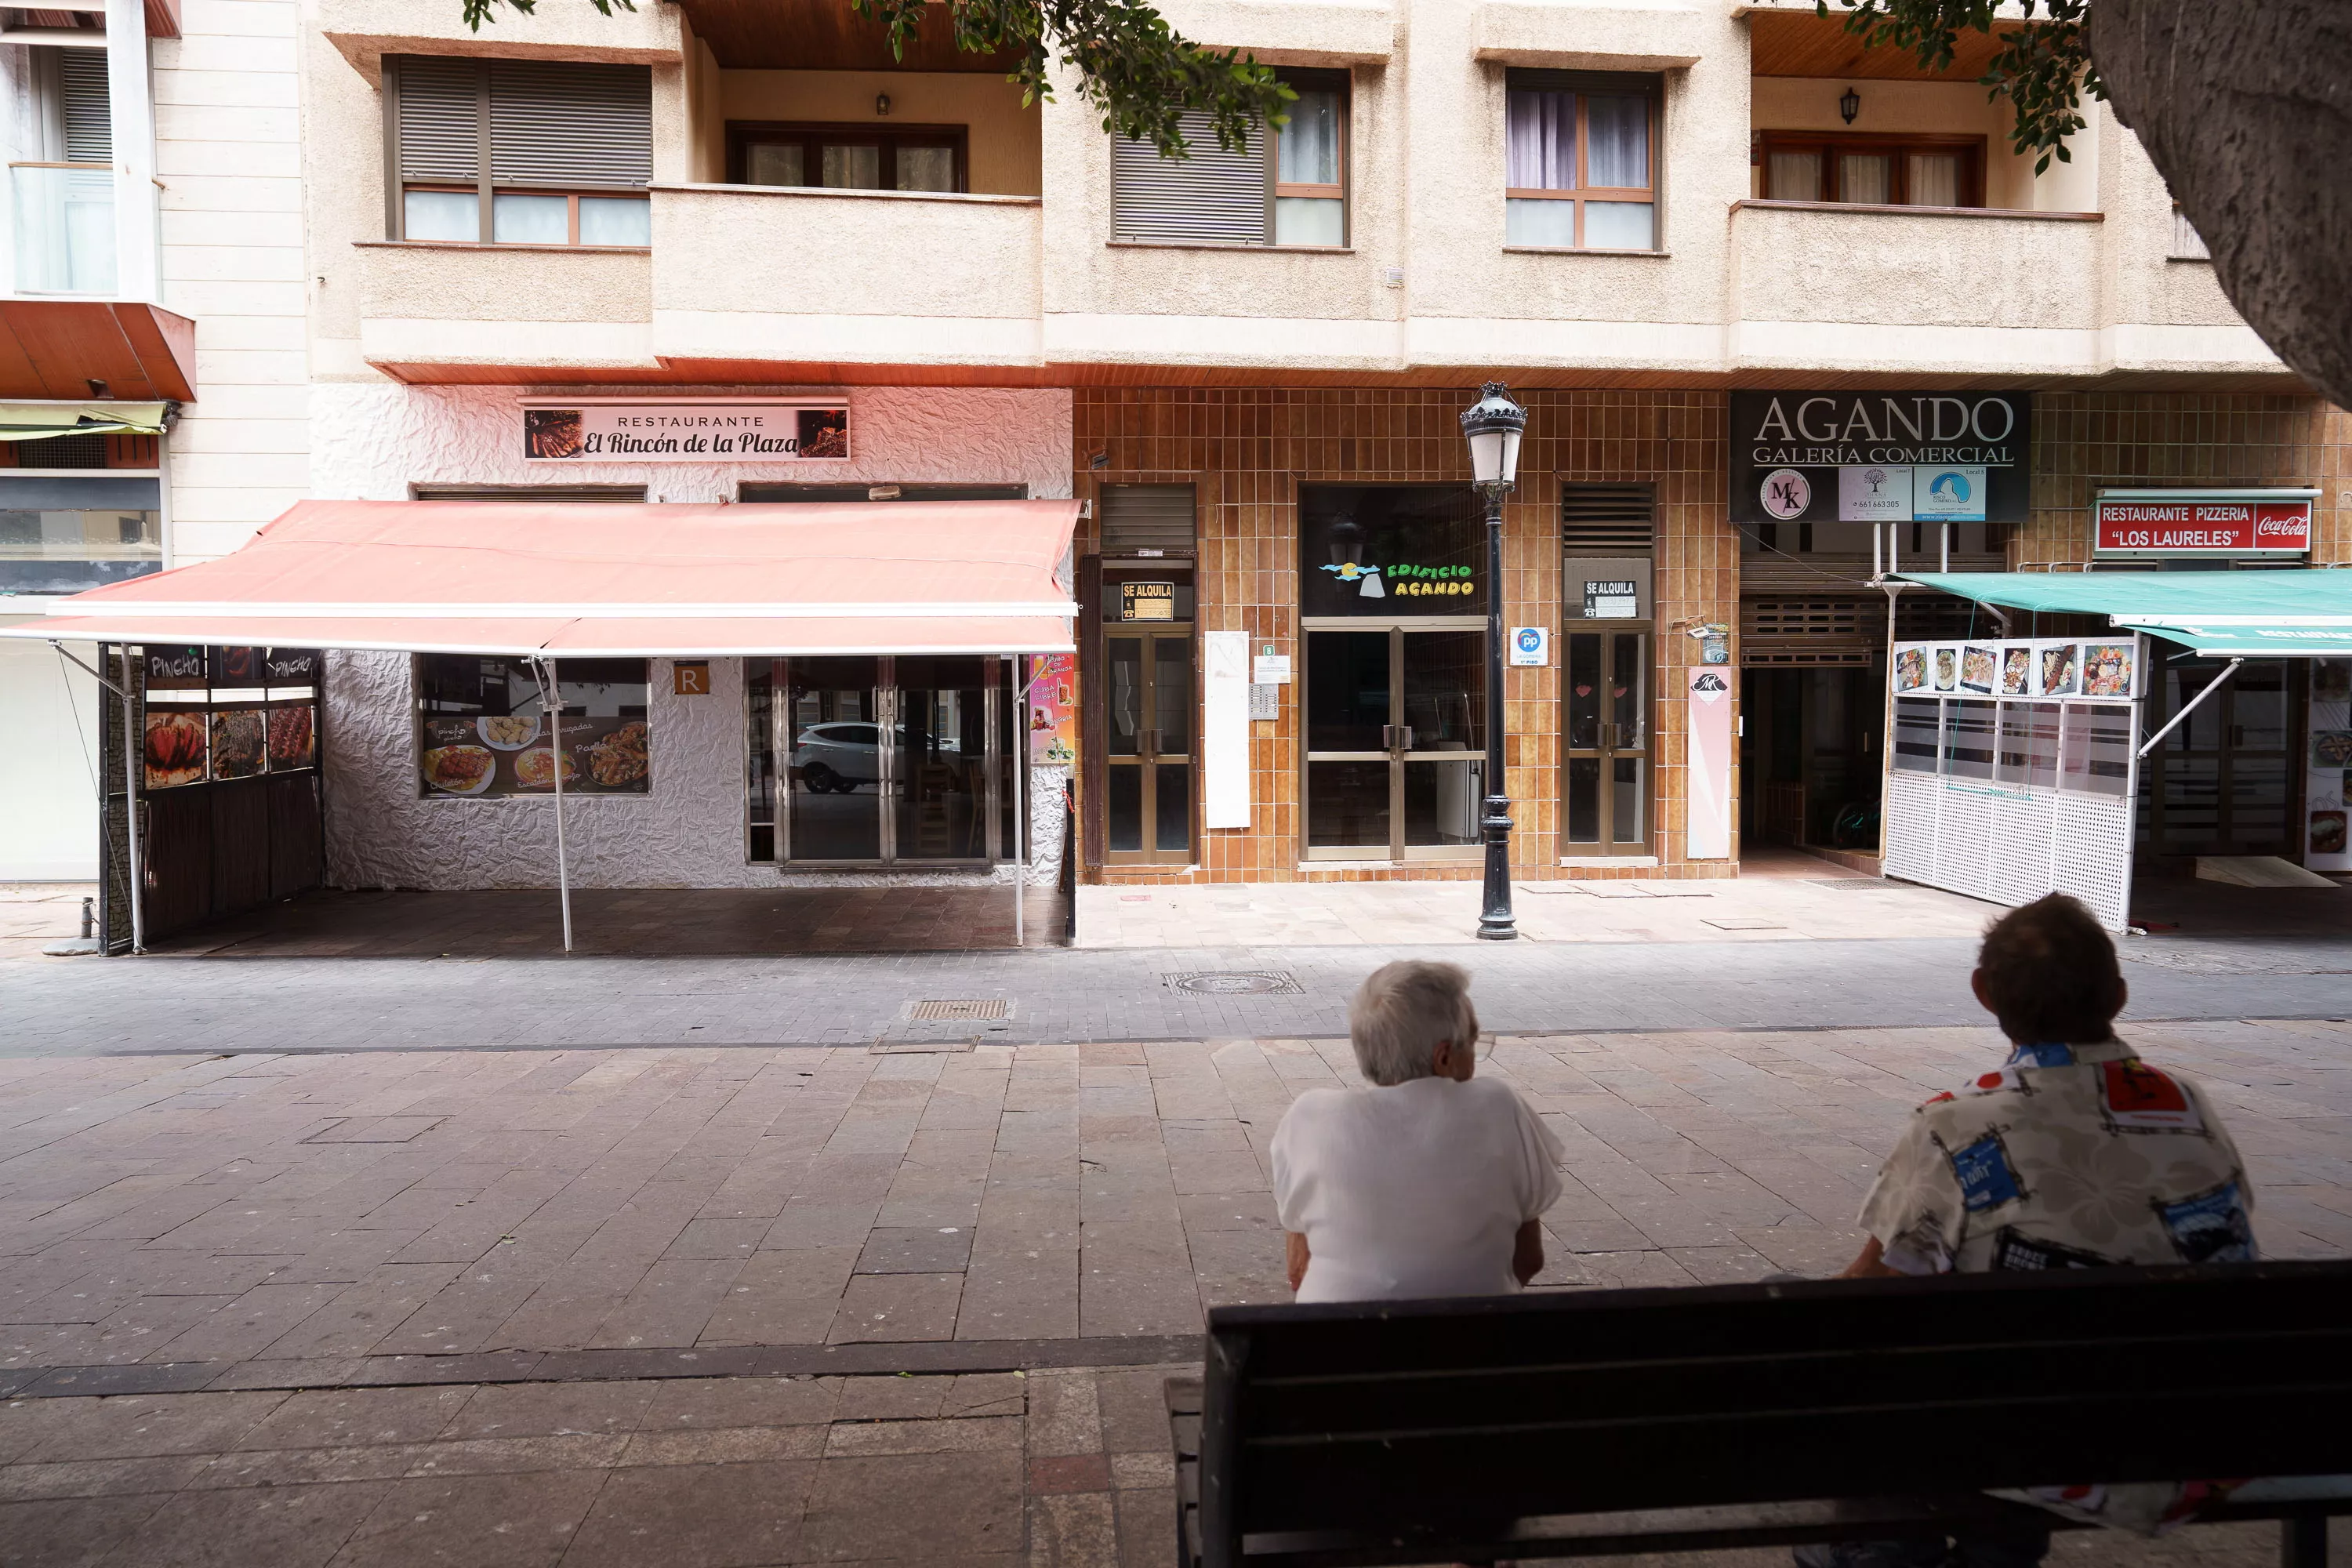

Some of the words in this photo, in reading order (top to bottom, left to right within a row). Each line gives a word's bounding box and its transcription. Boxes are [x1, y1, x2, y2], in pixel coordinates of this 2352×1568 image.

[618, 416, 764, 427] RESTAURANTE
[1753, 397, 2014, 441] AGANDO
[583, 432, 602, 453] El
[607, 432, 679, 454] Rincón
[684, 433, 708, 454] de
[713, 433, 734, 454] la
[738, 432, 799, 454] Plaza
[1752, 445, 1863, 463] GALERÍA
[1869, 446, 2015, 463] COMERCIAL
[2103, 507, 2189, 521] RESTAURANTE
[2196, 507, 2249, 521] PIZZERIA
[2258, 516, 2307, 536] Coca-Cola
[1387, 564, 1472, 579] EDIFICIO
[1123, 585, 1134, 597] SE
[1136, 585, 1171, 597] ALQUILA
[1395, 582, 1474, 597] AGANDO
[1586, 583, 1597, 594] SE
[1598, 583, 1634, 594] ALQUILA
[151, 655, 200, 678] PINCHO
[274, 655, 312, 678] PINCHO
[682, 670, 700, 691] R
[1034, 684, 1054, 694] CUBA
[1035, 691, 1057, 701] LIBRE
[2005, 1243, 2049, 1263] BRUCE
